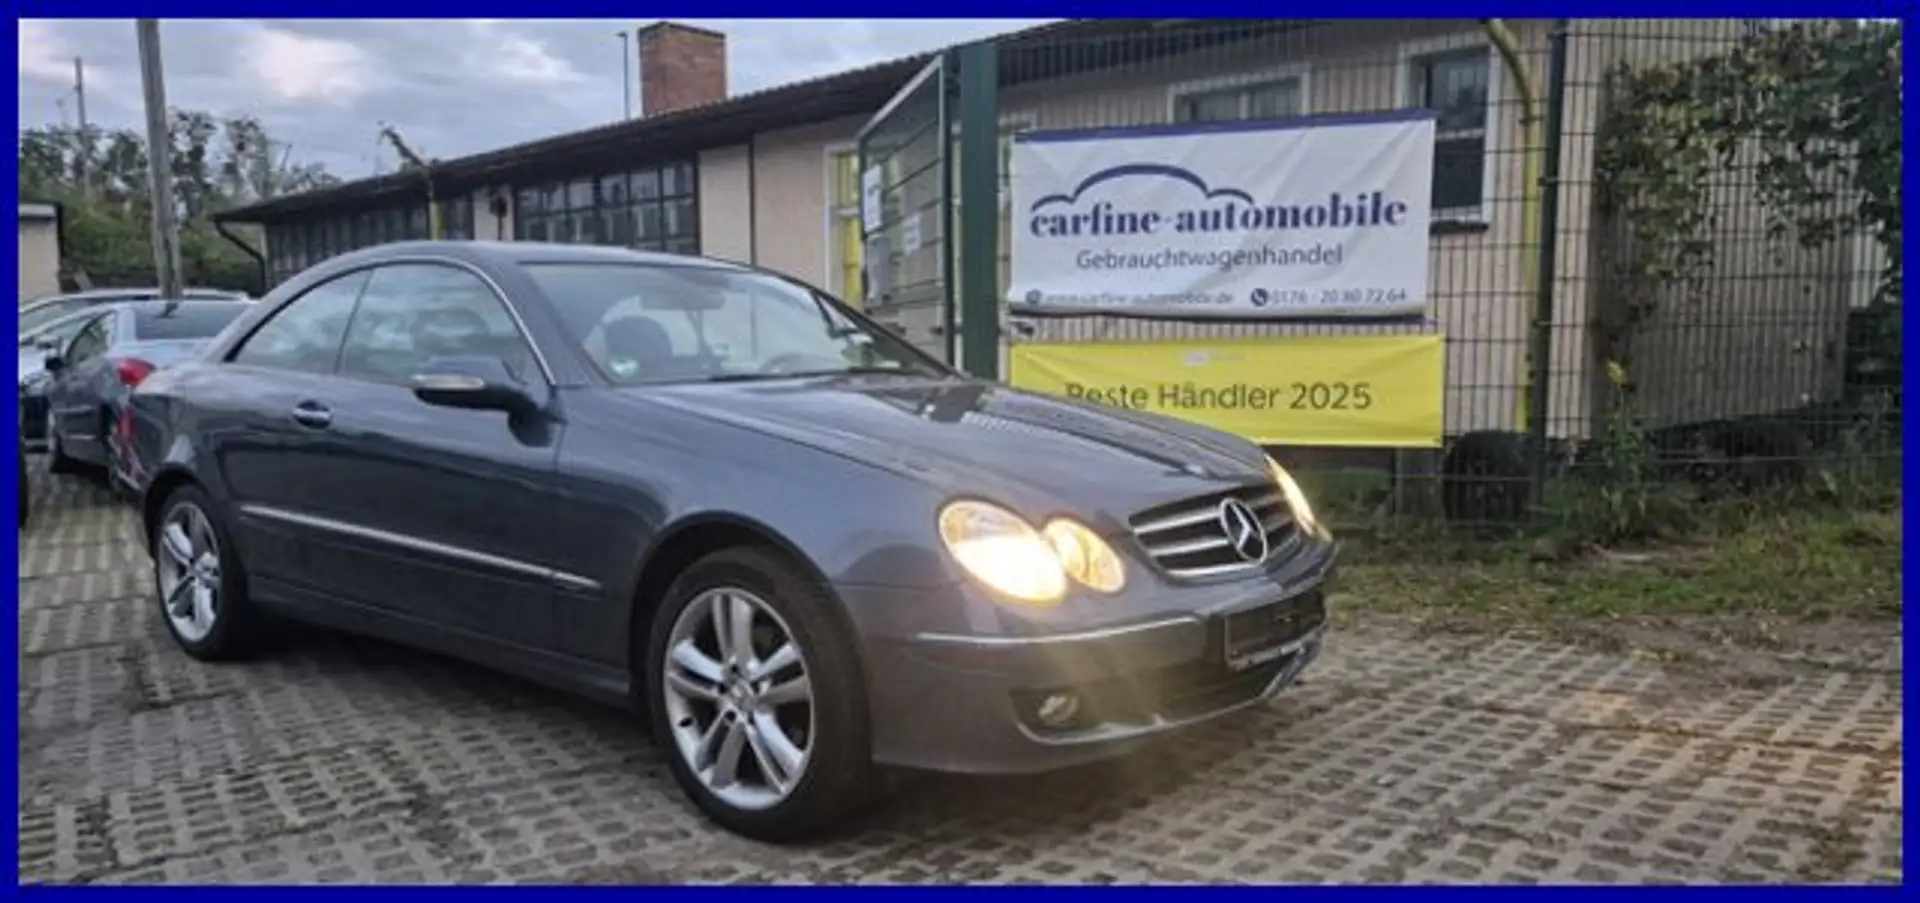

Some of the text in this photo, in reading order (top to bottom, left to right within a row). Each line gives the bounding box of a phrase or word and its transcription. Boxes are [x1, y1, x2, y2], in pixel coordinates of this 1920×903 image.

[1076, 243, 1343, 272] Gebrauchtwagenhandel
[1159, 381, 1280, 409] Händler
[1290, 381, 1373, 410] 2025
